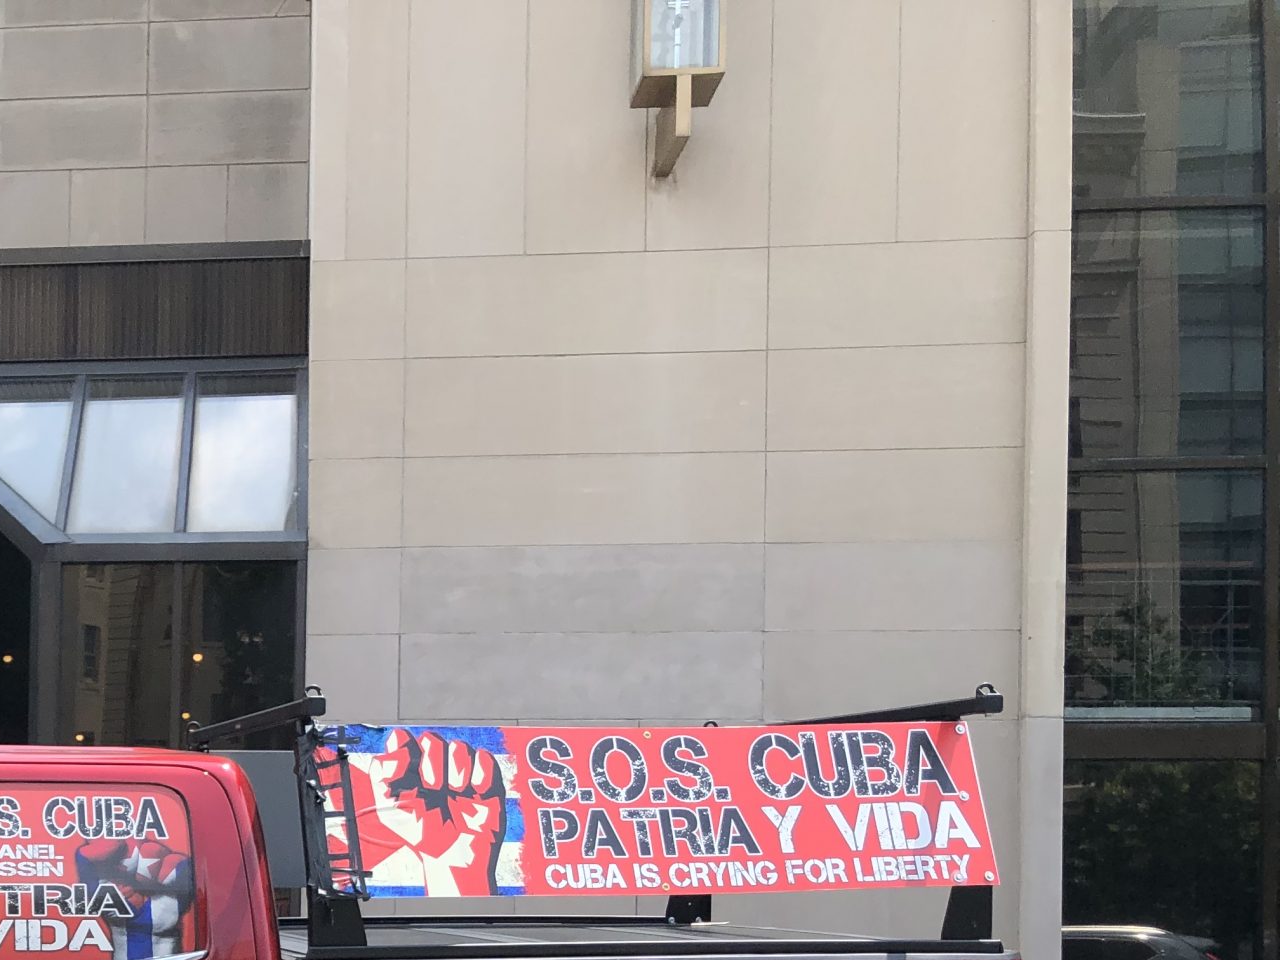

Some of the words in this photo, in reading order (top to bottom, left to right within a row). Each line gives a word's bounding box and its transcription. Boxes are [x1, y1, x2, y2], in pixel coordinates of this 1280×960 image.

[526, 735, 732, 803] S.O.S.
[748, 729, 960, 800] CUBA
[43, 796, 169, 839] CUBA
[537, 806, 762, 858] PATRIA
[761, 805, 802, 854] Y
[825, 801, 981, 851] VIDA
[544, 863, 627, 889] CUBA
[633, 863, 661, 888] IS
[668, 860, 778, 888] CRYING
[785, 857, 848, 885] FOR
[853, 854, 970, 882] LIBERTY
